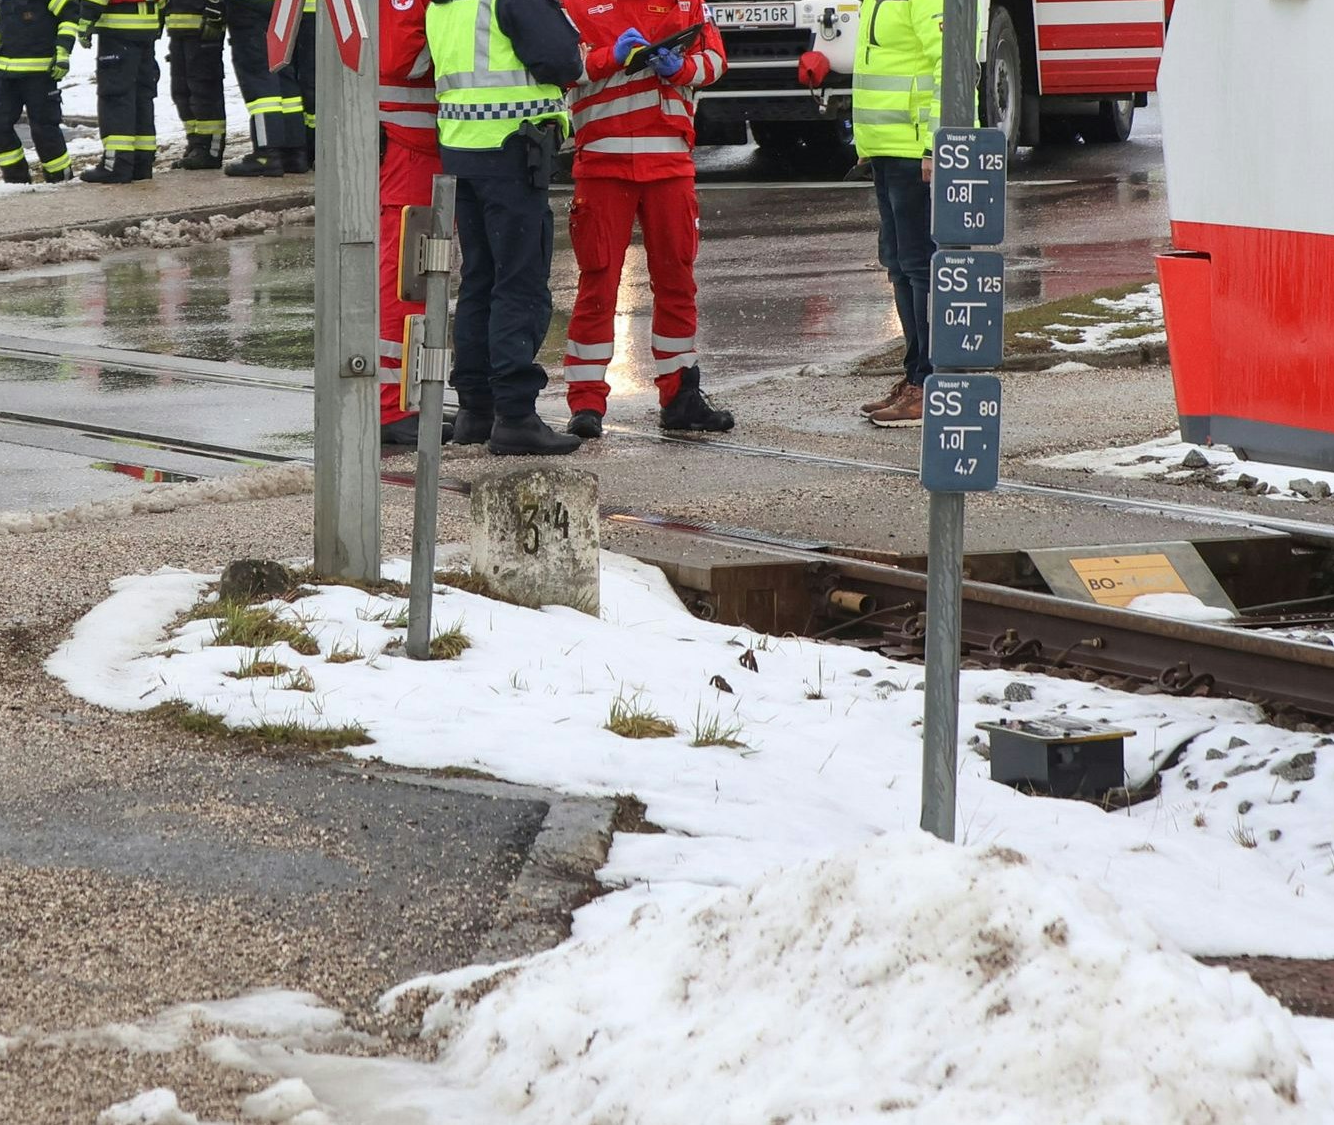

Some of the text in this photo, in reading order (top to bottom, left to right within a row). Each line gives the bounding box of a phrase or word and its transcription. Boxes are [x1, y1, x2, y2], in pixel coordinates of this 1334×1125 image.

[716, 9, 734, 23] FW
[745, 7, 788, 23] 251GR
[969, 134, 976, 142] Nr
[939, 144, 1003, 170] SS 125
[963, 212, 985, 228] 5,0
[967, 257, 974, 265] Nr
[937, 267, 1002, 292] SS 125
[961, 334, 983, 351] 4,7
[937, 380, 970, 388] Wasser Nr
[929, 391, 998, 416] SS 80
[954, 458, 978, 475] 4,7
